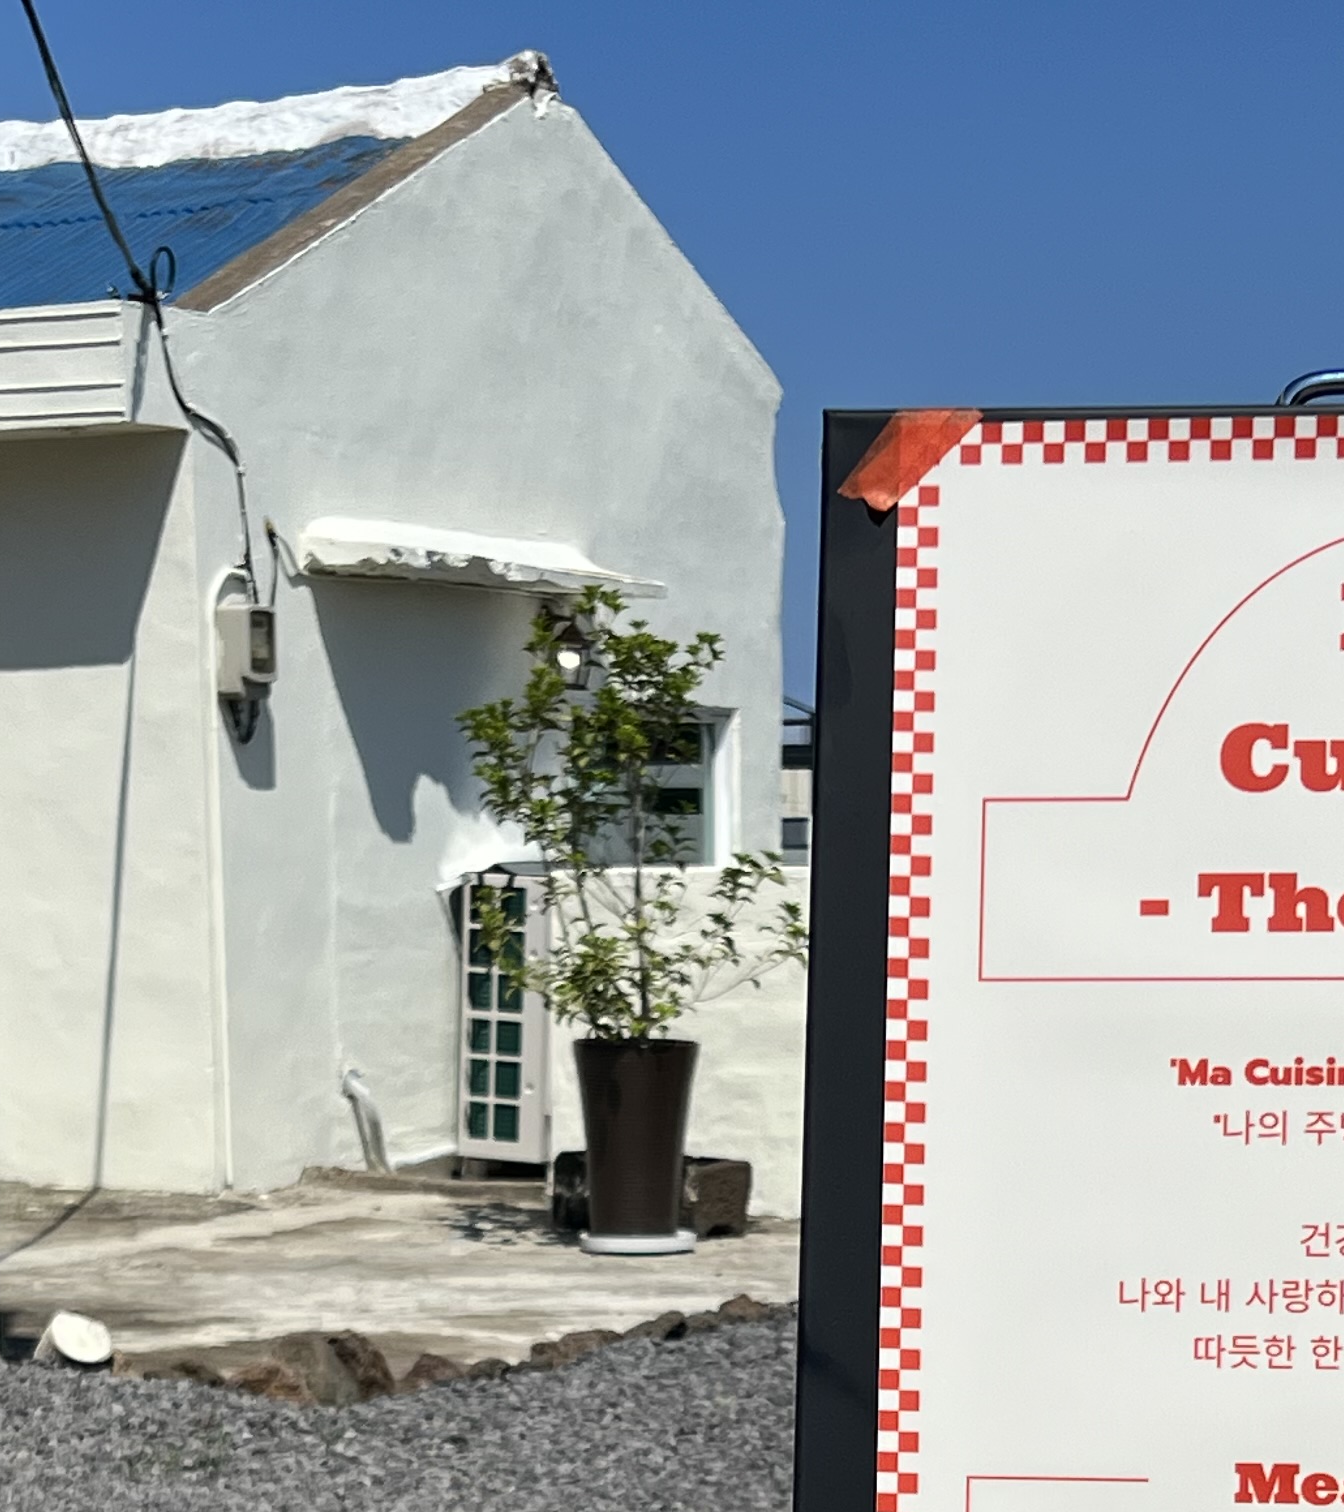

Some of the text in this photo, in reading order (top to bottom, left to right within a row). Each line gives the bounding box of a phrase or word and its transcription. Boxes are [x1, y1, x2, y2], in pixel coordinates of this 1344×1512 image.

[1140, 899, 1169, 916] -
[1119, 1278, 1186, 1313] 나와
[1201, 1279, 1230, 1312] 내
[1194, 1335, 1296, 1369] 따듯한
[1311, 1336, 1343, 1370] 한
